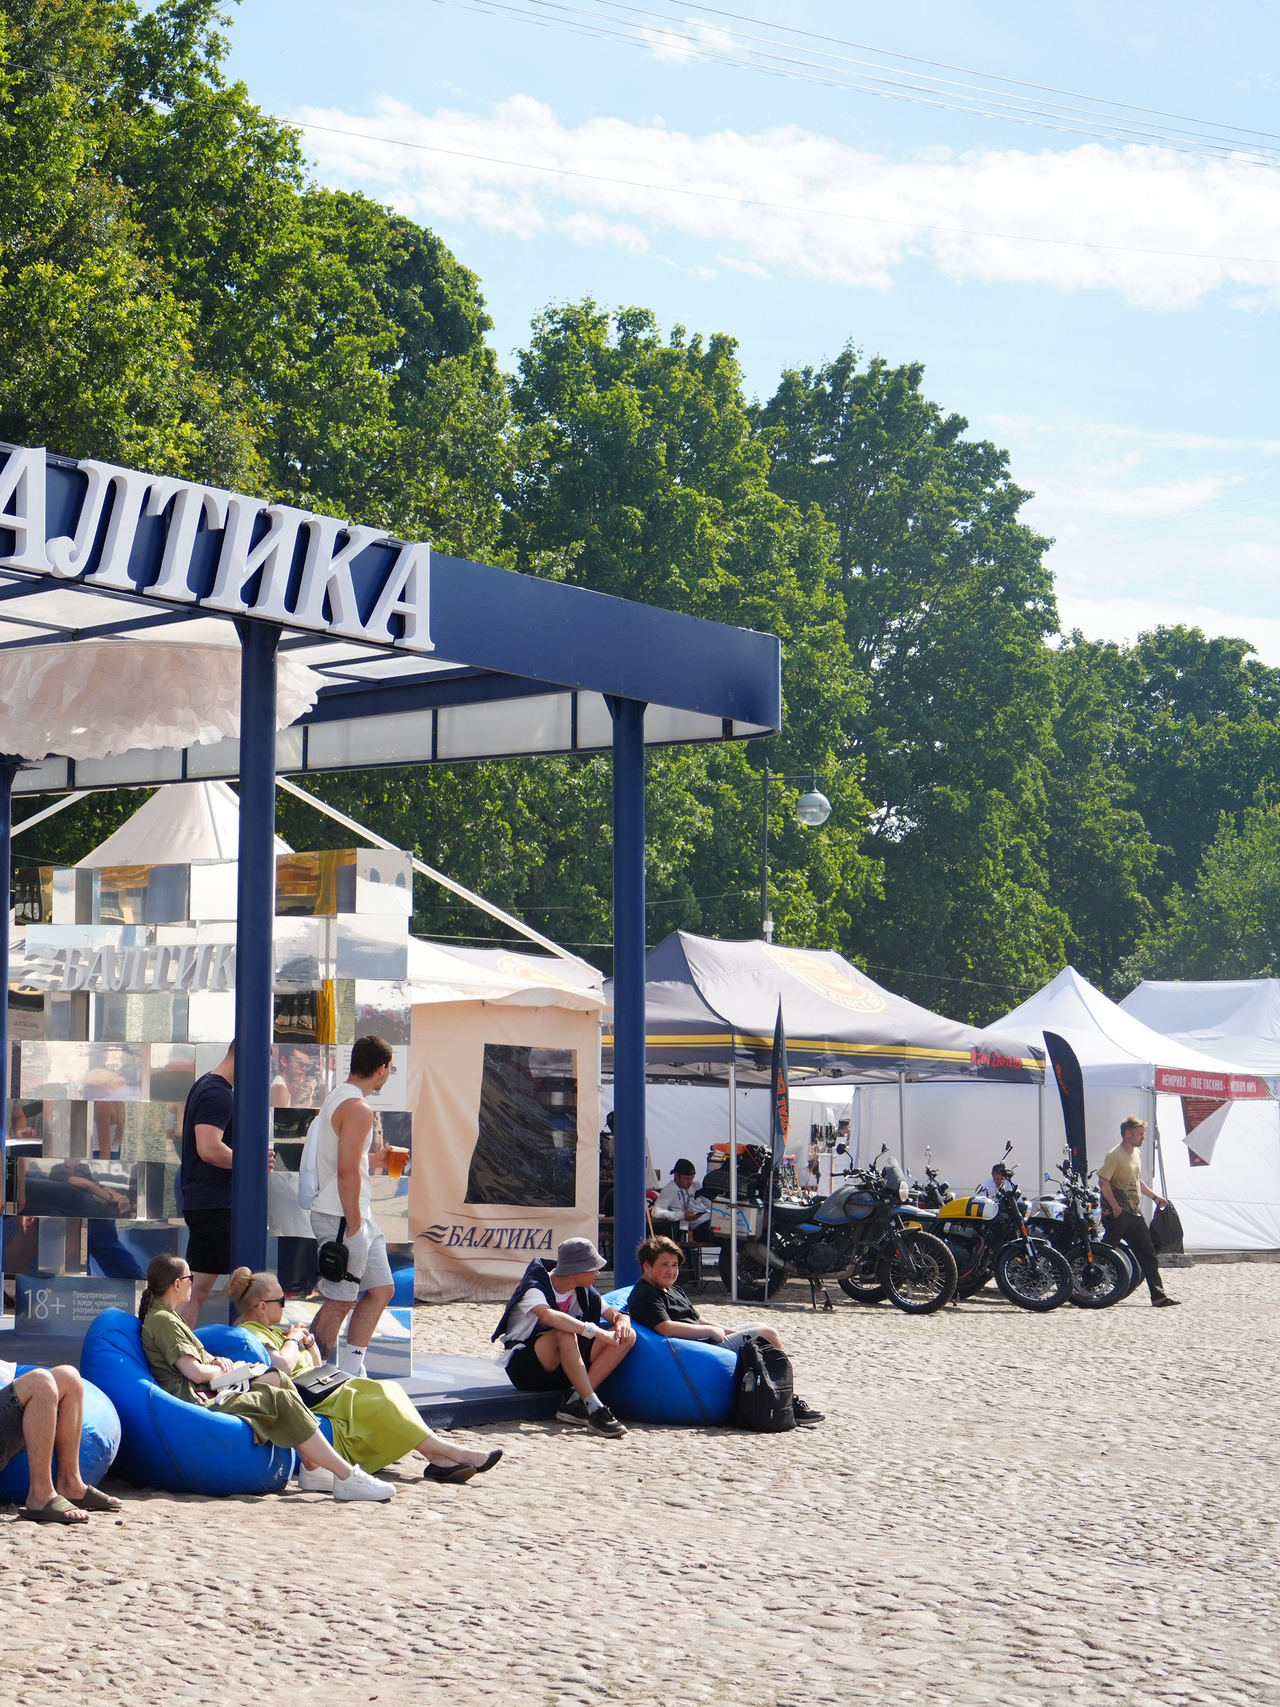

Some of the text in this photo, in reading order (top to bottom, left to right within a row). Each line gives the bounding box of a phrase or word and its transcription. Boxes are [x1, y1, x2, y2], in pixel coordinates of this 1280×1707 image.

[58, 943, 236, 992] БАЛТИК
[445, 1225, 553, 1250] БАЛТИКА
[25, 1289, 65, 1320] 18+
[72, 1290, 117, 1299] Предупреждаем
[72, 1306, 102, 1314] употребле
